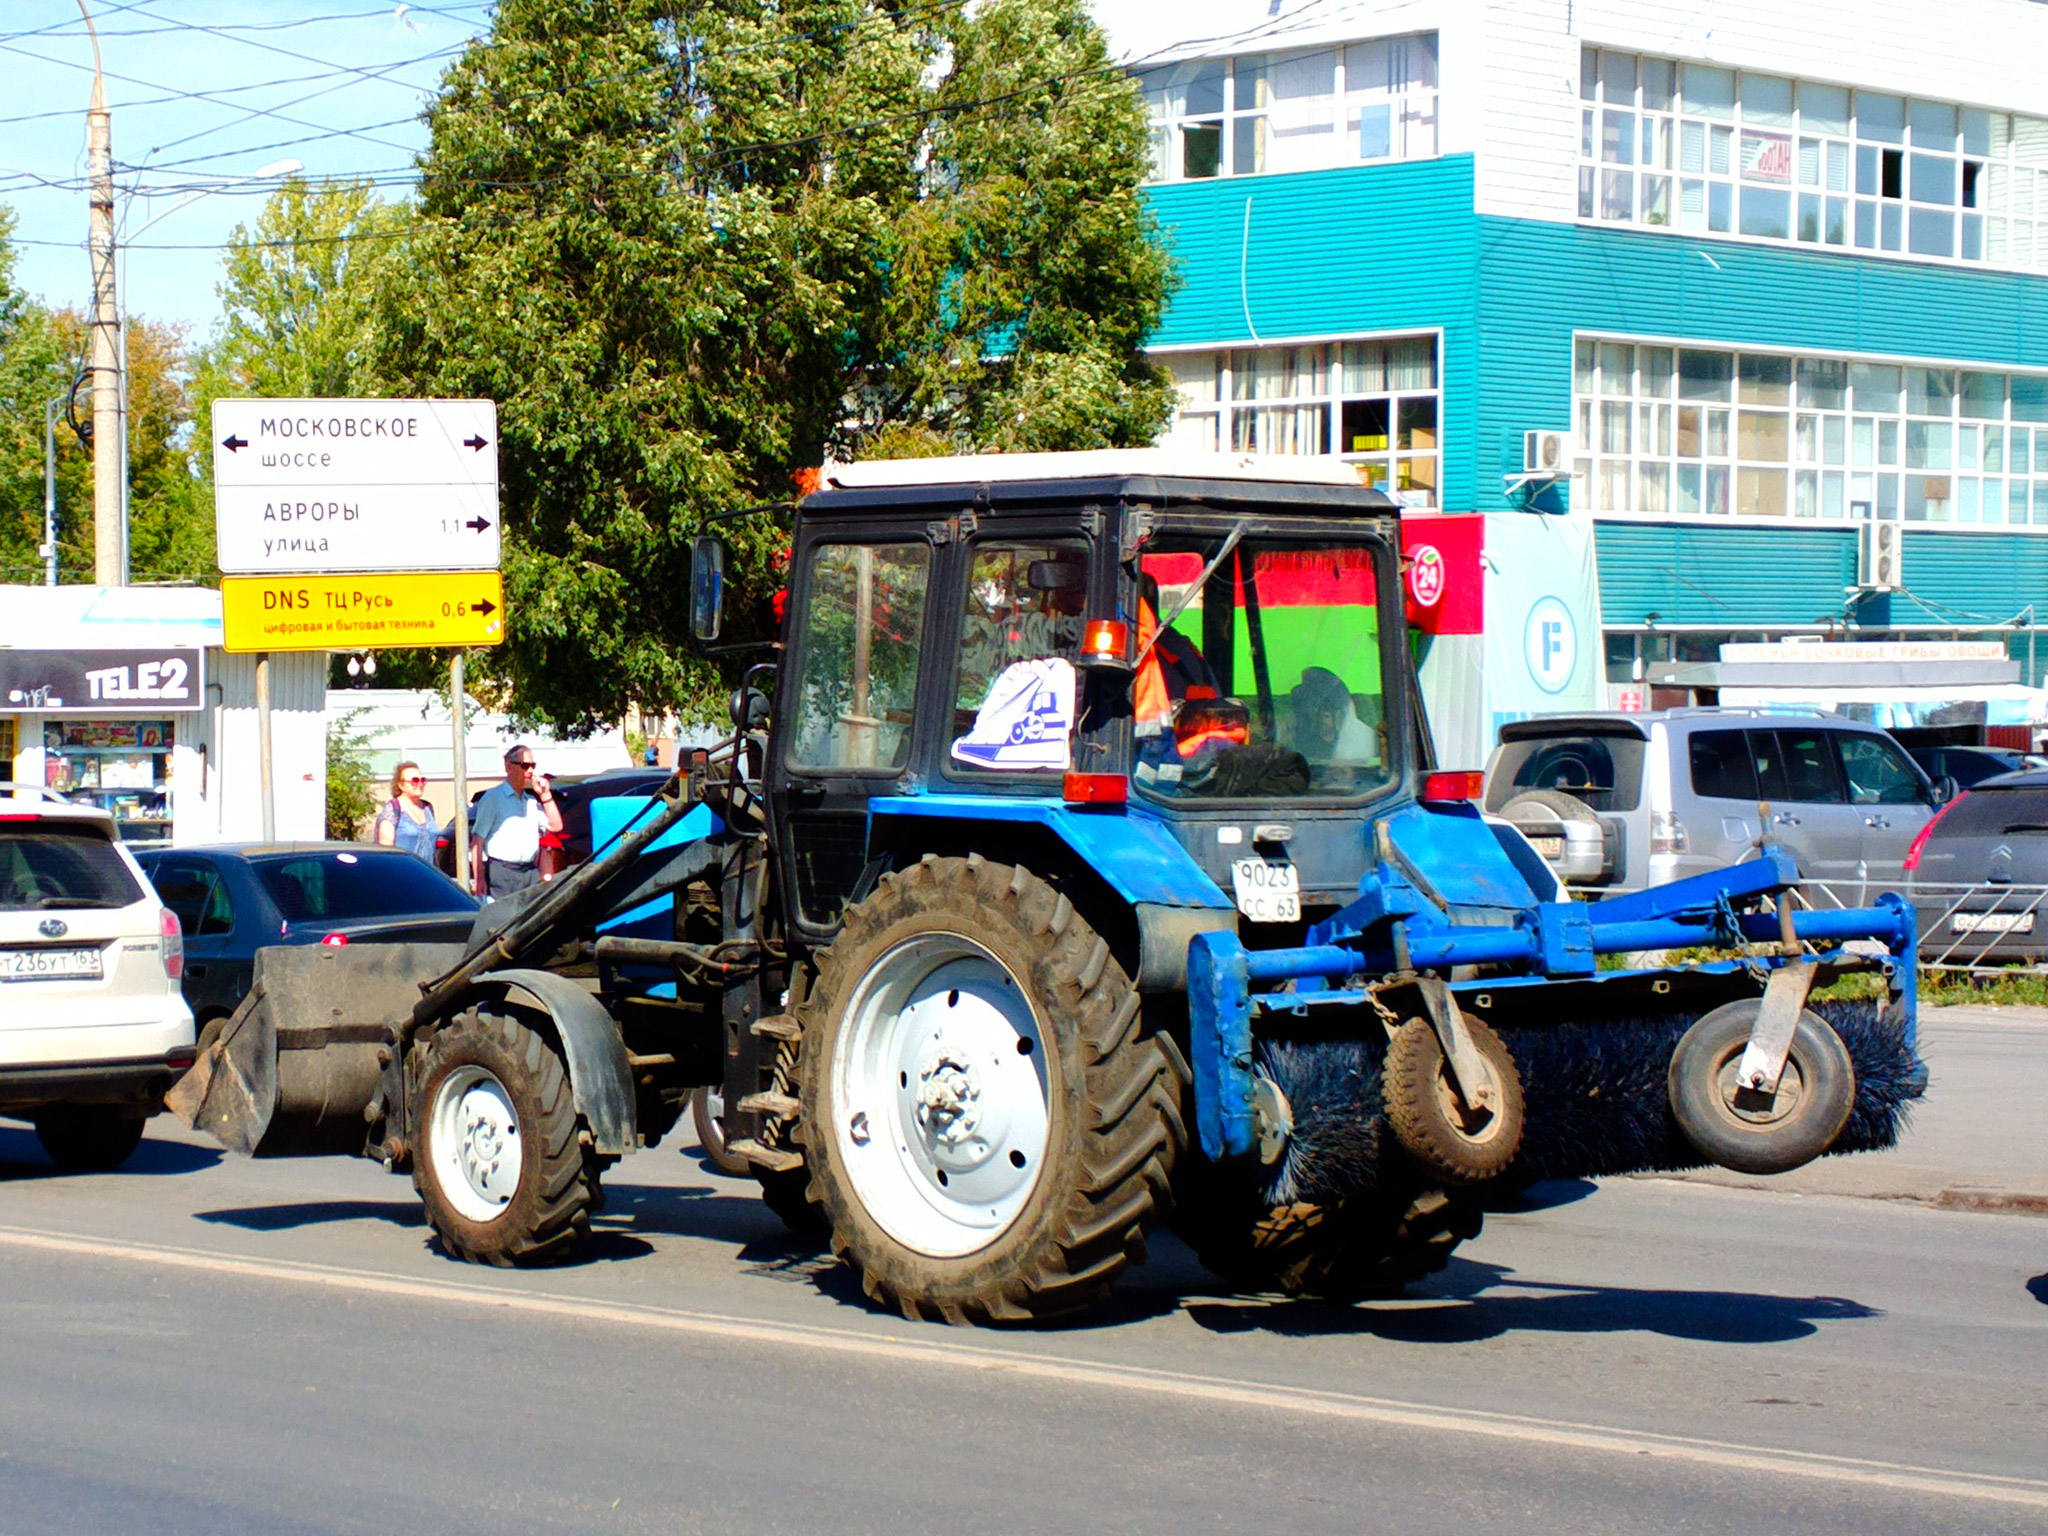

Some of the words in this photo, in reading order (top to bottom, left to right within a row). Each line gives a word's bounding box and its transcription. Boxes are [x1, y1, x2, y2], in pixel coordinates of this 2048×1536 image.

[260, 418, 418, 437] МОСКОВСКОЕ
[261, 453, 331, 467] шоссе
[263, 502, 359, 522] АВРОРЫ
[263, 537, 329, 557] улица
[1418, 565, 1437, 589] 24
[264, 590, 310, 610] DNS
[324, 592, 347, 610] ТЦ
[353, 592, 393, 612] Русь
[441, 601, 466, 619] 0,6
[263, 622, 322, 635] цифровая
[326, 623, 333, 631] и
[336, 618, 385, 631] бытовая
[388, 619, 435, 629] техника
[1948, 645, 2000, 657] ОВОЩИ
[85, 658, 188, 699] TELE2
[1241, 863, 1290, 887] 9023
[1277, 898, 1295, 917] 63
